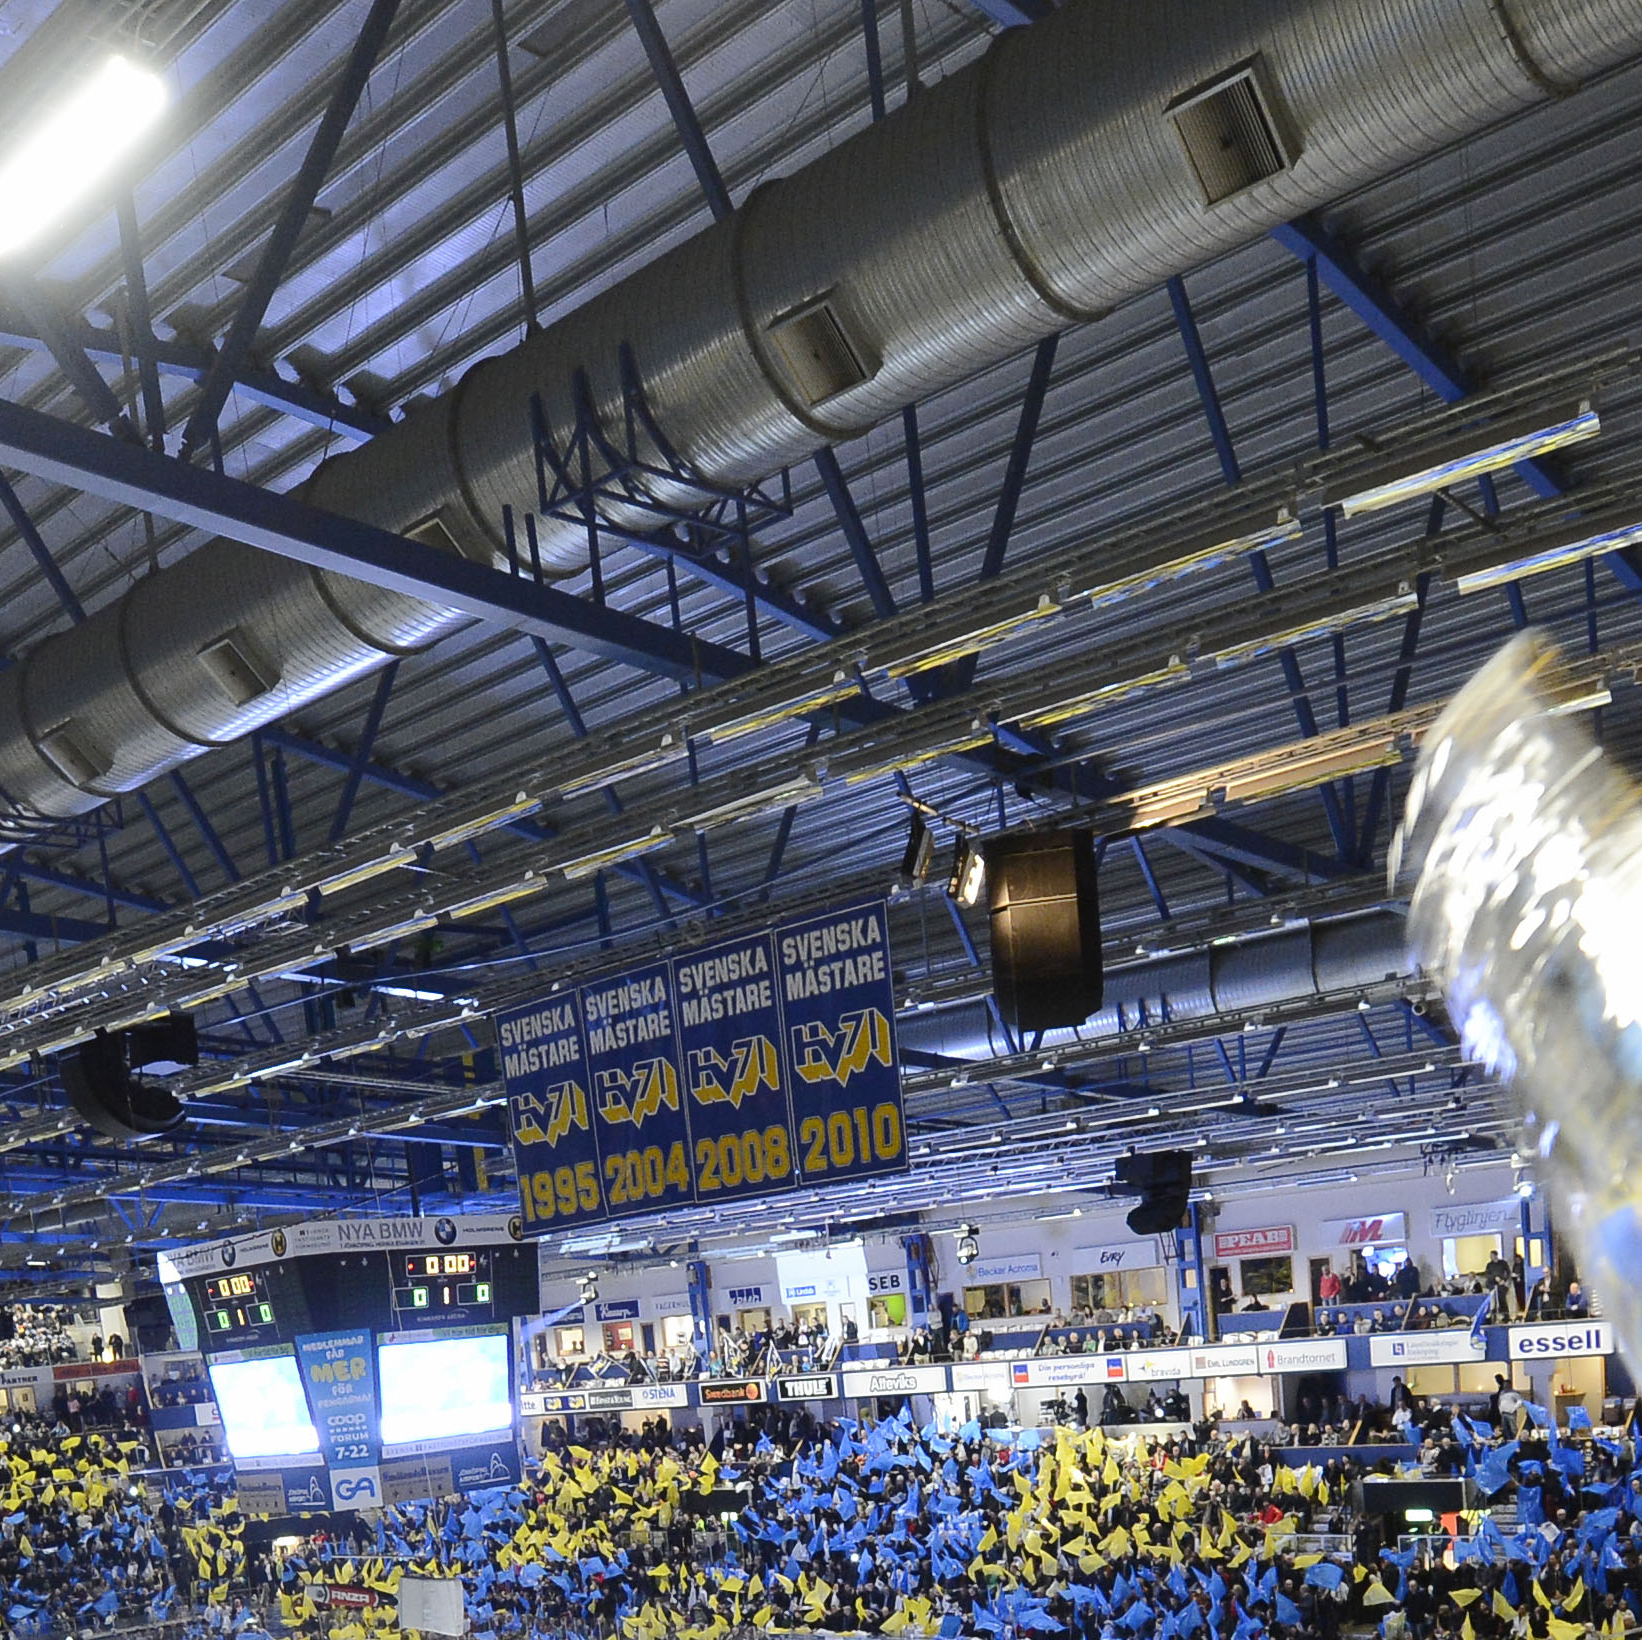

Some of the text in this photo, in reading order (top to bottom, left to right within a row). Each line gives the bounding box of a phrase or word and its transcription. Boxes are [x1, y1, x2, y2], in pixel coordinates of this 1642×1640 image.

[782, 915, 882, 965] SVENSKA
[678, 945, 769, 994] SVENSKA
[786, 951, 886, 1001] MÄSTARE
[586, 976, 667, 1022] SVENSKA
[682, 979, 772, 1027] MÄSTARE
[500, 1005, 575, 1047] SVENSKA
[590, 1009, 671, 1055] MÄSTARE
[504, 1036, 580, 1079] MÄSTARE
[800, 1102, 903, 1173] 2010
[696, 1124, 791, 1191] 2008
[605, 1141, 689, 1204] 2004
[520, 1161, 599, 1222] 1995
[337, 1222, 375, 1241] NYA
[379, 1221, 424, 1240] BMW
[1227, 1230, 1280, 1249] PEAB
[978, 1264, 1006, 1277] Becker
[868, 1274, 901, 1291] SEB
[413, 1288, 427, 1307] 0
[443, 1286, 450, 1305] 1
[476, 1283, 490, 1302] 0
[218, 1311, 231, 1329] 0
[259, 1304, 273, 1323] 0
[1518, 1329, 1602, 1354] essell
[1277, 1352, 1336, 1365] Brandtornet
[310, 1357, 366, 1383] MER
[650, 1387, 676, 1399] STENA
[705, 1387, 745, 1400] Swedbank
[785, 1379, 828, 1397] THULE
[330, 1432, 369, 1443] FORUM
[335, 1444, 370, 1460] 7-22
[331, 1589, 370, 1603] ANZA
